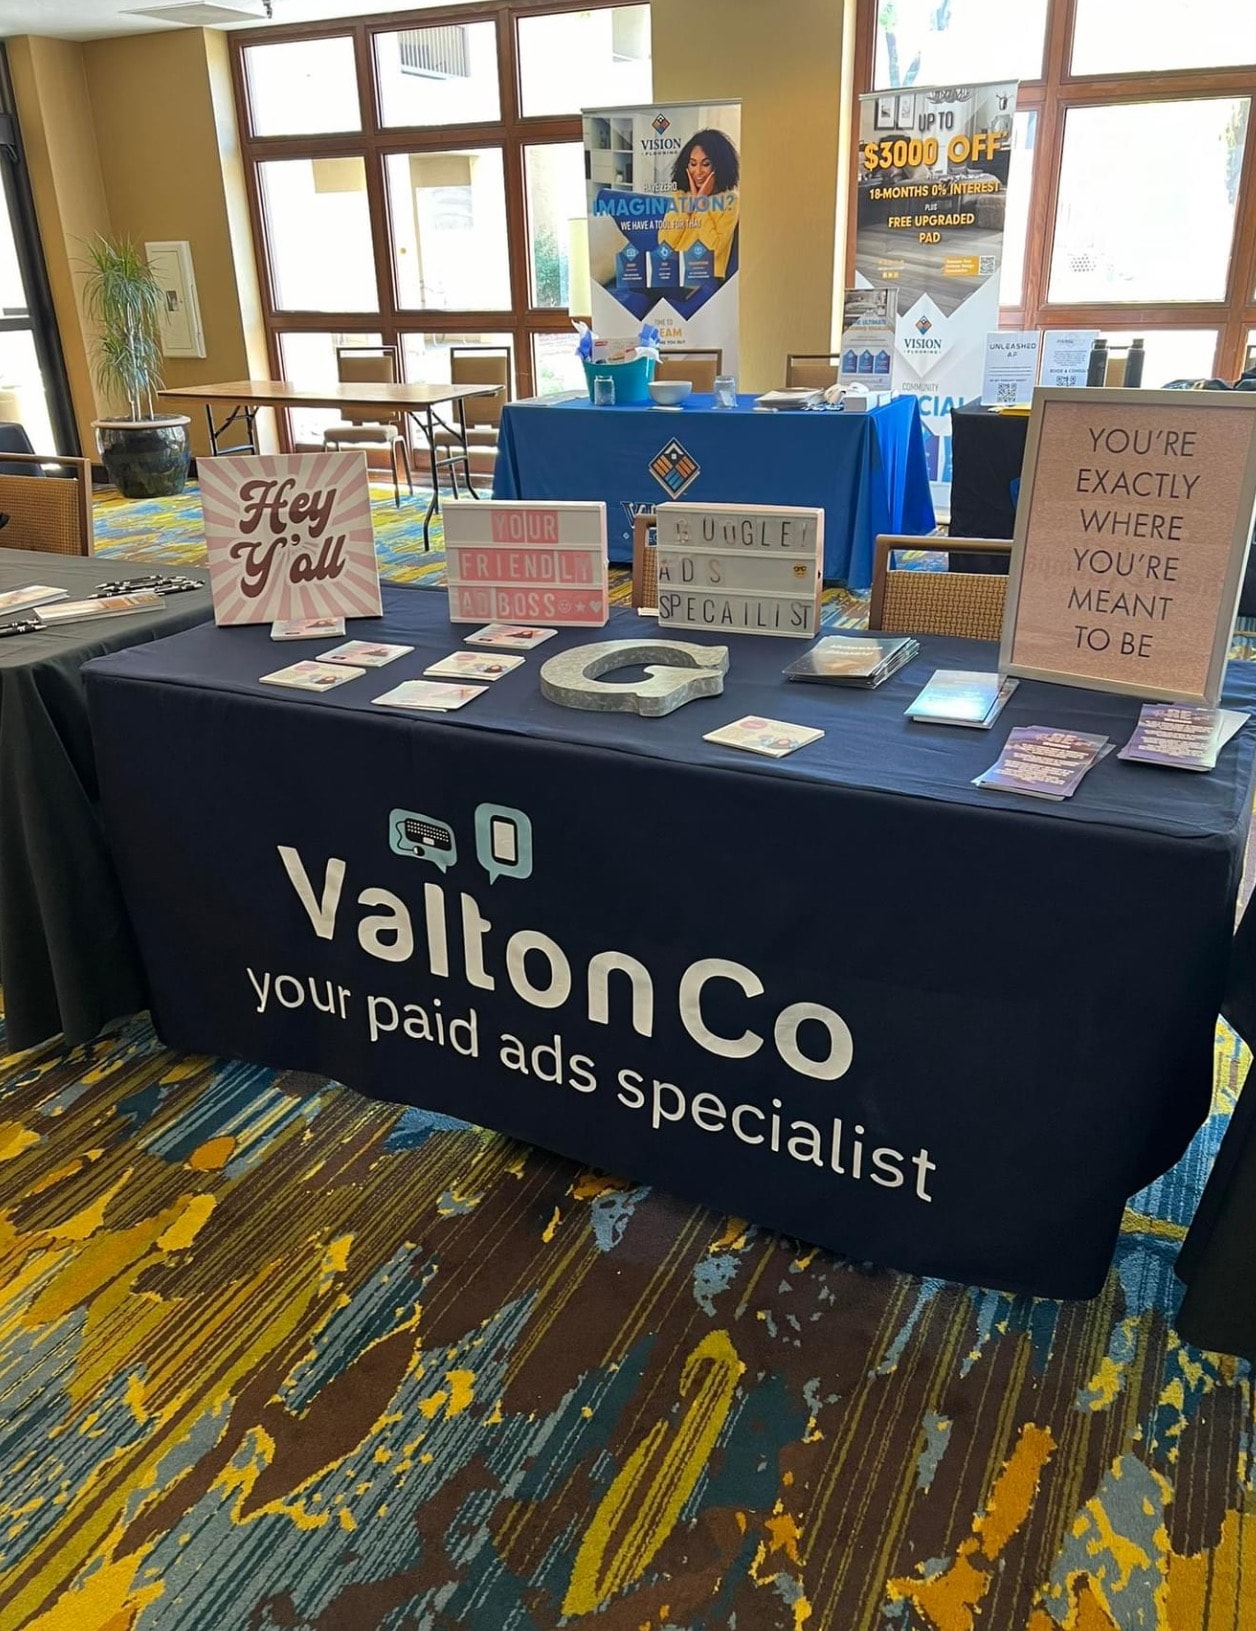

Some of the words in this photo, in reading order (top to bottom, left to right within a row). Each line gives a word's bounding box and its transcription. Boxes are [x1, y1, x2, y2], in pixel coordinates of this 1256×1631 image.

[918, 113, 936, 132] UP
[938, 111, 954, 130] TO
[641, 138, 682, 151] VISION
[864, 137, 939, 172] $3000
[661, 181, 678, 193] ZERO
[869, 185, 929, 200] 18-MONTHS
[931, 184, 947, 196] 0%
[950, 182, 999, 195] INTEREST
[592, 194, 735, 217] IMAGINATION?
[924, 203, 938, 211] PLUS
[620, 221, 632, 231] WE
[632, 220, 649, 231] HAVE
[649, 220, 655, 229] A
[655, 219, 672, 230] TOOL
[672, 220, 684, 230] FOR
[888, 216, 912, 228] FREE
[915, 213, 975, 227] UPGRADED
[919, 232, 941, 243] PAD
[659, 327, 683, 338] EAM
[904, 338, 942, 349] VISION
[989, 342, 1037, 350] UNLEASHED
[902, 382, 940, 392] COMMUNITY
[1089, 427, 1197, 457] YOU'RE
[1076, 468, 1201, 500] EXACTLY
[239, 478, 337, 539] Hey
[494, 514, 557, 540] YOUR
[1079, 508, 1185, 541] WHERE
[230, 533, 346, 598] Y'all
[461, 552, 590, 583] FRIENDLY
[659, 557, 721, 584] ADS
[1073, 547, 1180, 582] YOU'RE
[463, 590, 488, 616] AD
[500, 592, 556, 617] BOSS
[658, 594, 811, 630] SPECAILIST
[1067, 586, 1173, 621] MEANT
[1074, 625, 1110, 651] TO
[1120, 631, 1153, 658] BE
[277, 845, 853, 1081] ValtonCo
[246, 967, 351, 1020] your
[367, 998, 479, 1058] paid
[500, 1034, 597, 1093] ads
[617, 1069, 936, 1202] specialist
